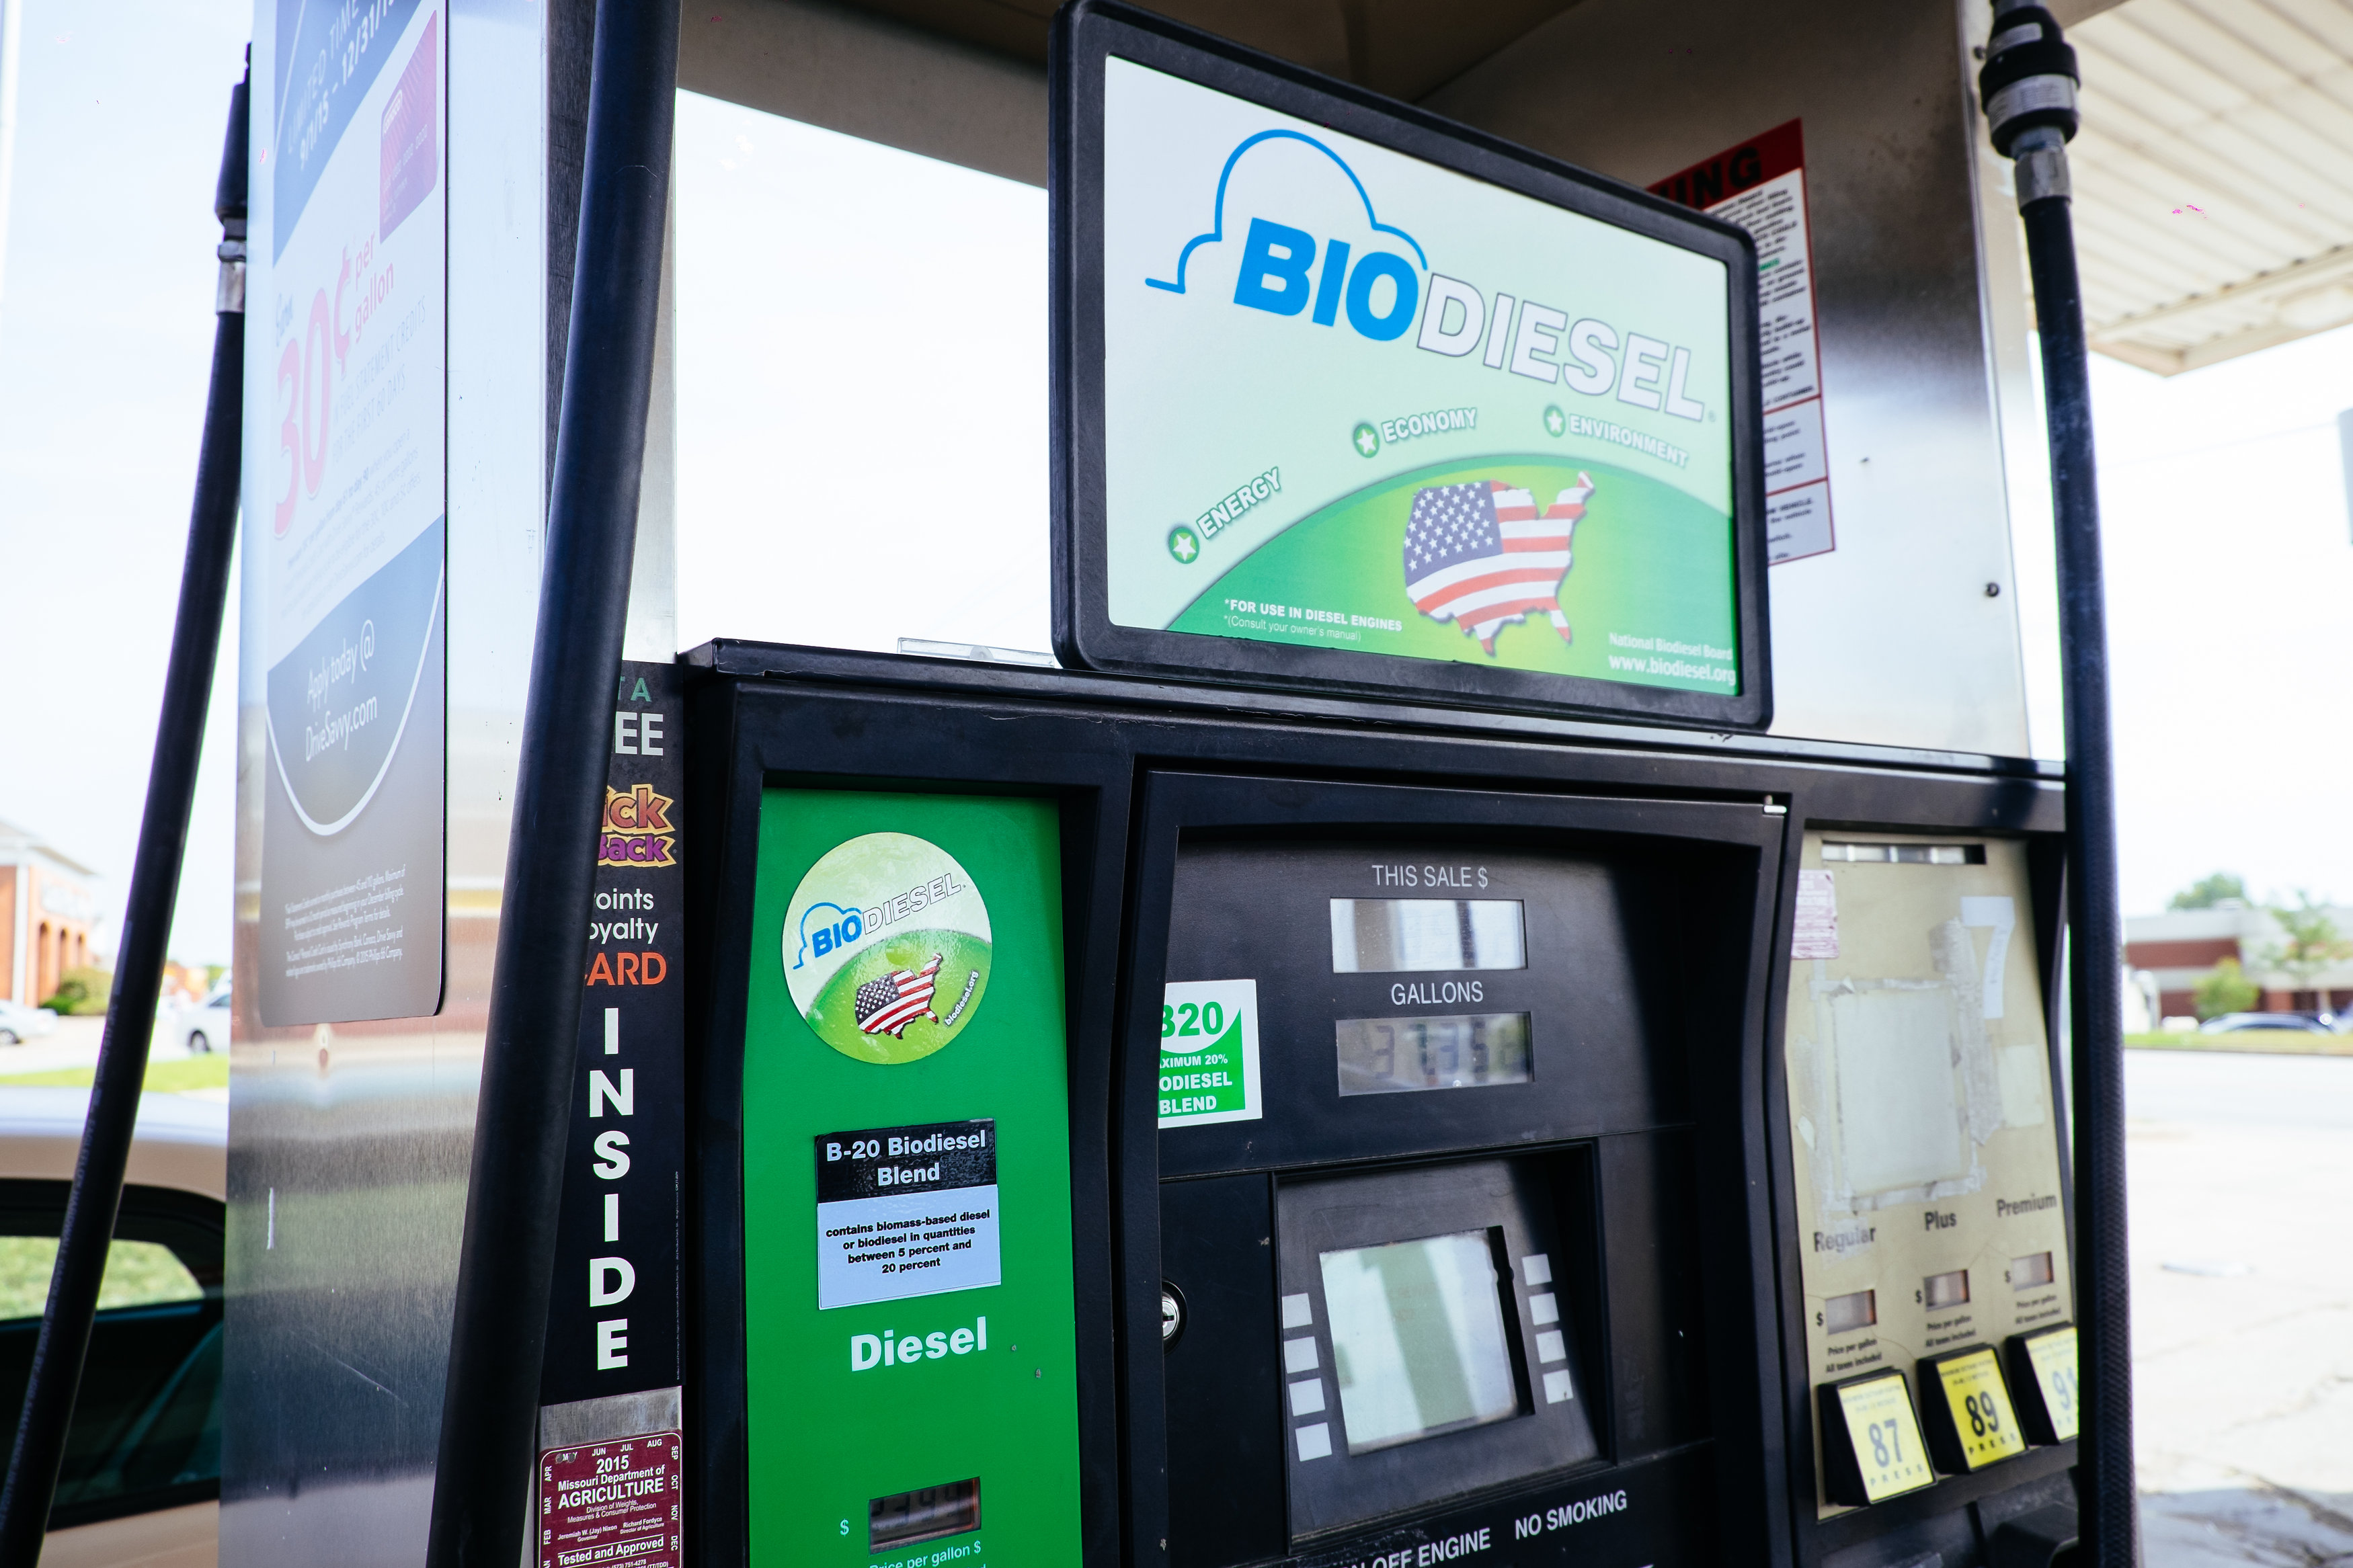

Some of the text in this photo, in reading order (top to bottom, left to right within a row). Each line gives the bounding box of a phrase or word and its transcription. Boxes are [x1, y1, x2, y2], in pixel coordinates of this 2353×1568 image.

[1674, 147, 1762, 208] ING
[355, 231, 376, 291] per
[354, 262, 394, 345] gallon
[396, 294, 426, 358] CREDITS
[387, 362, 405, 405] DAYS
[1382, 407, 1478, 444] ECONOMY
[1569, 414, 1689, 468] ENVIRONMENT
[1196, 466, 1282, 538] ENERGY
[1260, 602, 1285, 617] USE
[1289, 606, 1302, 618] IN
[1306, 608, 1348, 625] DIESEL
[1351, 614, 1403, 632] ENGINES
[1269, 620, 1288, 634] your
[1290, 622, 1325, 638] owner's
[1326, 627, 1362, 643] manual)
[1608, 632, 1733, 661] National Biodiesel Board
[306, 618, 375, 713] Apply today @
[1607, 653, 1737, 686] www.biodiesel.org
[305, 695, 378, 763] DriveSavvy.com
[614, 711, 664, 756] EE
[1372, 864, 1488, 891] THIS SALE $
[595, 888, 655, 910] oints
[811, 873, 962, 959] BIODIESEL
[589, 917, 659, 945] oyalty
[586, 952, 667, 986] ARD
[944, 970, 980, 1027] biodiesel.org
[1390, 981, 1484, 1006] GALLONS
[1160, 1053, 1229, 1069] XIMUM 20%
[1159, 1071, 1233, 1092] ODIESEL
[1160, 1096, 1218, 1115] BLEND
[826, 1130, 986, 1162] B-20 Biodiesel
[589, 1007, 636, 1370] INSIDE
[877, 1163, 941, 1187] Blend
[1996, 1192, 2057, 1218] Premium
[826, 1208, 991, 1238] contains biomass-based diesel
[1924, 1210, 1957, 1231] Plus
[842, 1225, 976, 1251] or biodiesel in quantities
[1812, 1225, 1877, 1253] Regular
[848, 1239, 972, 1265] between 5 percent and
[881, 1257, 941, 1274] 20 percent
[1915, 1290, 1923, 1305] $
[1816, 1311, 1824, 1328] $
[850, 1315, 988, 1372] Diesel
[1827, 1337, 1878, 1357] Price per gallon
[1825, 1363, 1836, 1374] All
[1855, 1352, 1882, 1367] included
[1965, 1390, 2000, 1438] 89
[592, 1448, 606, 1457] JUN
[620, 1443, 634, 1452] JUL
[647, 1438, 662, 1448] AUG
[1868, 1417, 1904, 1469] 87
[544, 1465, 553, 1482] APR
[596, 1454, 630, 1474] 2015
[557, 1464, 666, 1492] Missouri Department of
[543, 1496, 552, 1515] MAR
[557, 1477, 664, 1510] AGRICULTURE
[586, 1499, 639, 1514] Division of Weights,
[567, 1513, 595, 1524] Measures
[600, 1508, 629, 1518] Consumer
[629, 1502, 657, 1513] Protection
[623, 1516, 664, 1528] Richard Fordyce
[1515, 1489, 1628, 1540] NO SMOKING
[543, 1529, 551, 1545] FEB
[557, 1530, 581, 1540] Jeremiah
[589, 1526, 602, 1535] (Jay)
[602, 1524, 618, 1532] Nixon
[577, 1534, 598, 1542] Governor
[620, 1526, 637, 1534] Director
[642, 1522, 665, 1531] Agriculture
[840, 1518, 850, 1537] $
[558, 1549, 592, 1567] Tested
[594, 1545, 614, 1560] and
[615, 1536, 664, 1558] Approved
[670, 1535, 678, 1551] DEC
[906, 1555, 928, 1568] per
[931, 1544, 971, 1567] gallon
[973, 1540, 982, 1555] $
[1418, 1527, 1492, 1567] ENGINE
[625, 1558, 647, 1568] 751-4278
